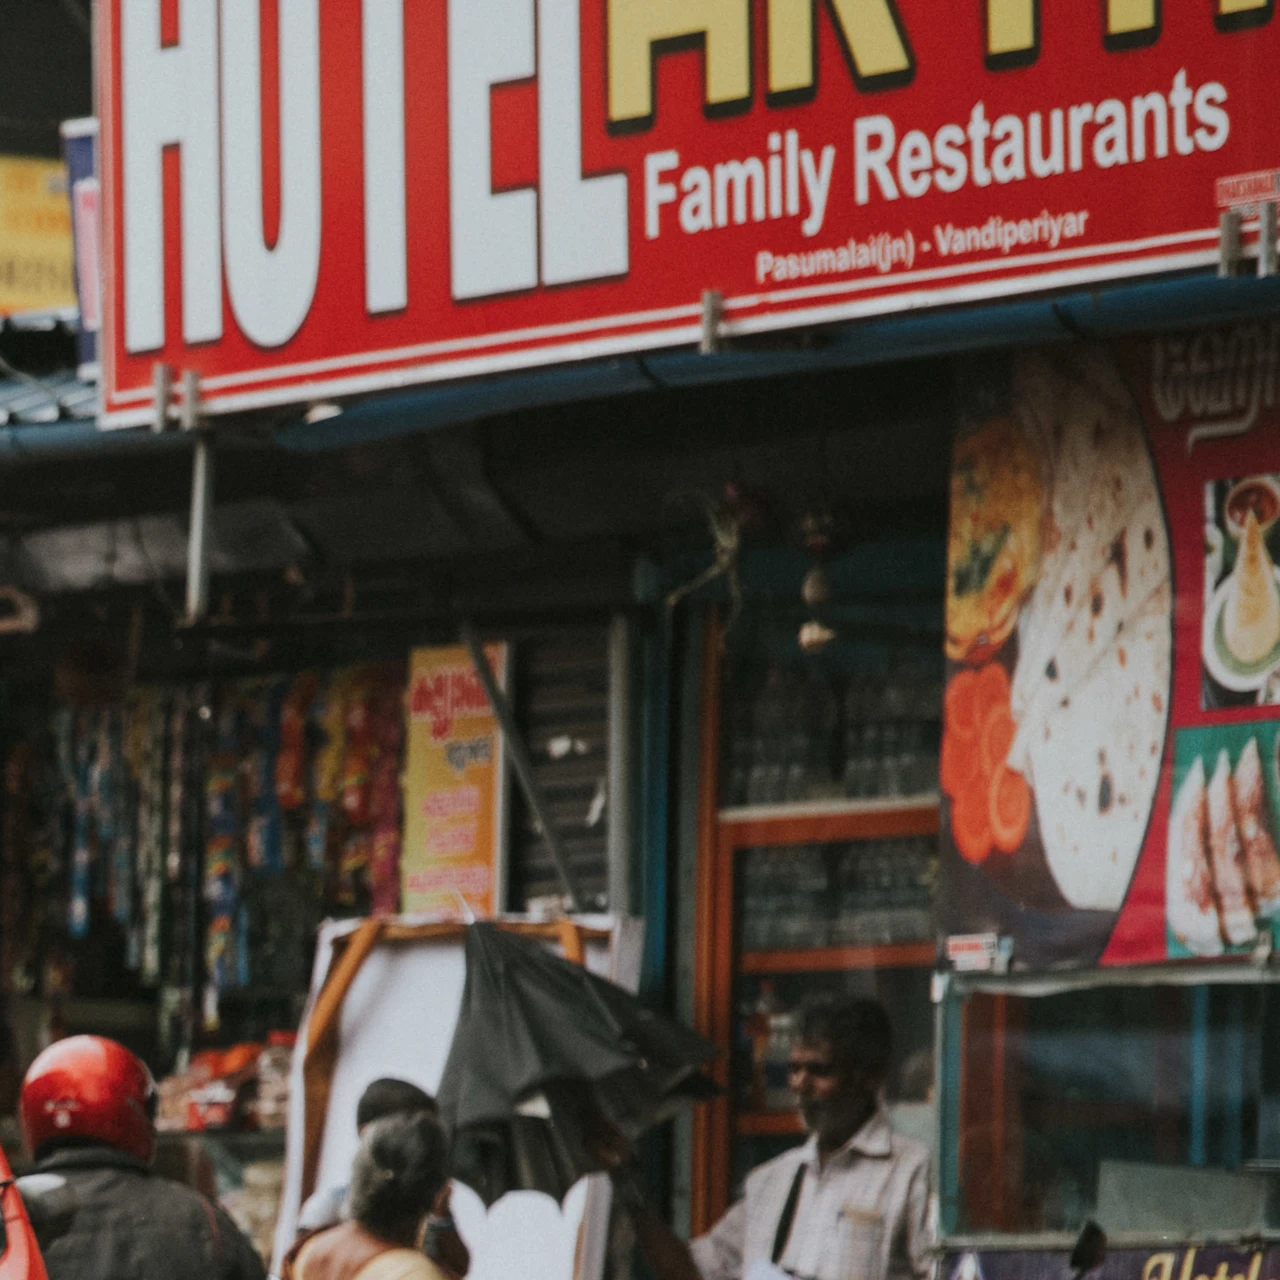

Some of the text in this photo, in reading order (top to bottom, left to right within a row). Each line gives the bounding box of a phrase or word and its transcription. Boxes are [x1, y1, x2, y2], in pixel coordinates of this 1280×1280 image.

[644, 66, 1231, 239] Family Restaurants
[755, 230, 915, 284] Pasumalai(jn)
[934, 209, 1090, 258] Vandiperiyar
